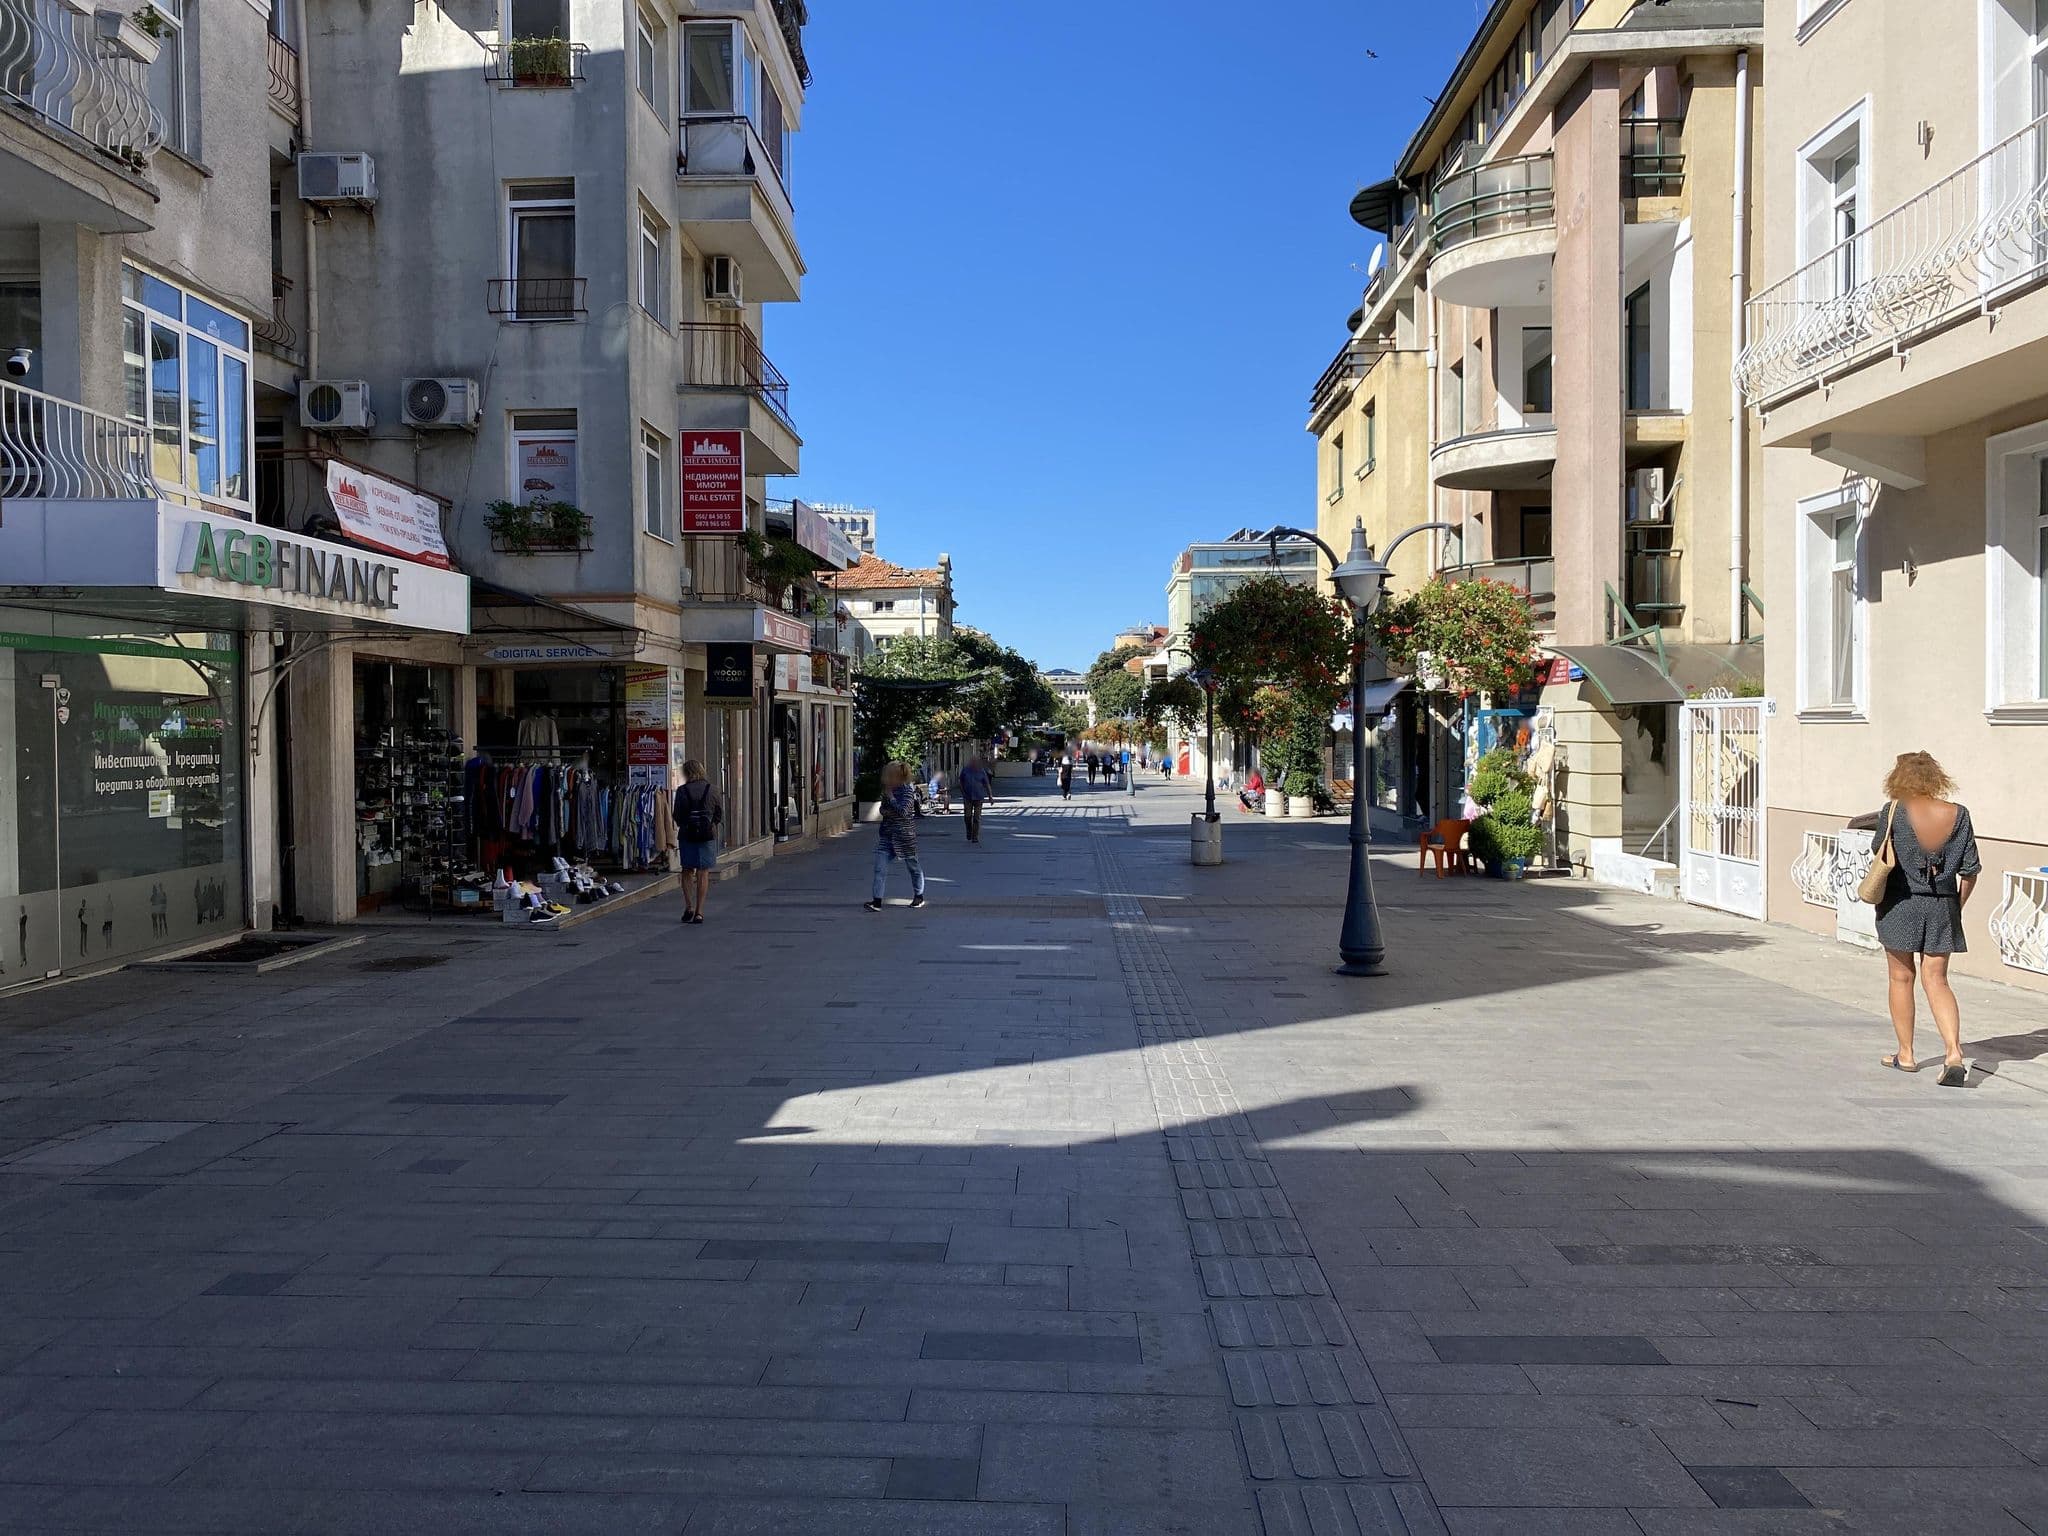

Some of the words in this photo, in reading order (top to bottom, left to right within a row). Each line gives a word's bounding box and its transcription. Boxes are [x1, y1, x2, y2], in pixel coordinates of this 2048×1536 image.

[684, 457, 707, 465] МЕГА
[708, 457, 739, 465] ИМОТИ
[685, 473, 739, 481] НЕДВИЖИМИ
[502, 649, 543, 659] DIGITAL
[545, 647, 593, 657] SERVICE
[94, 700, 161, 719] Ипотечни
[1767, 701, 1776, 713] 50
[94, 754, 172, 769] Инвестиционни
[175, 751, 213, 769] кредити
[214, 754, 220, 764] и
[95, 779, 133, 795] кредити
[134, 781, 144, 789] за
[145, 776, 185, 790] оборотни
[186, 773, 220, 788] средства
